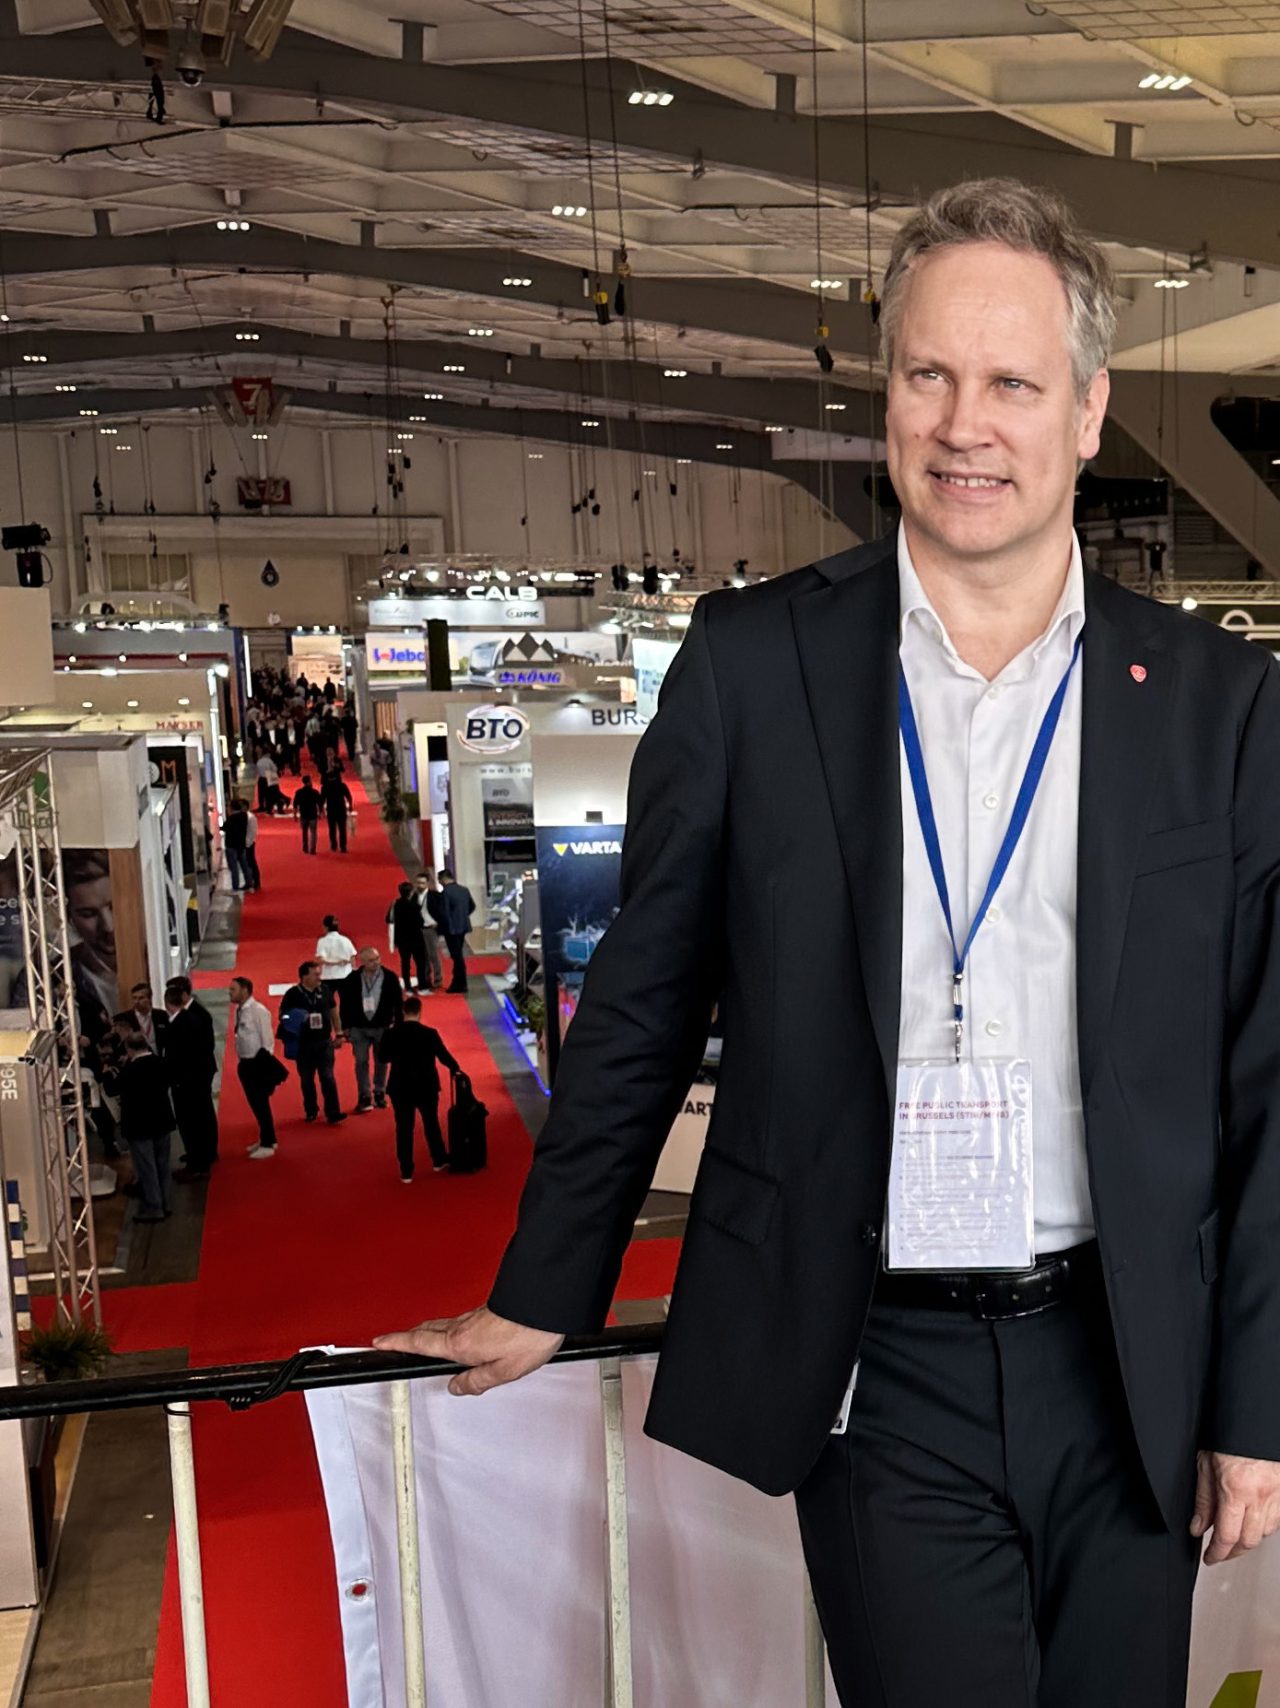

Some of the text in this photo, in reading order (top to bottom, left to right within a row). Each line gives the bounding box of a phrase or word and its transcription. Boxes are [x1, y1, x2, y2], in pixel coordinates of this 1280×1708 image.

[466, 586, 538, 600] CALB
[467, 718, 523, 739] BTO
[571, 842, 622, 855] VARTA
